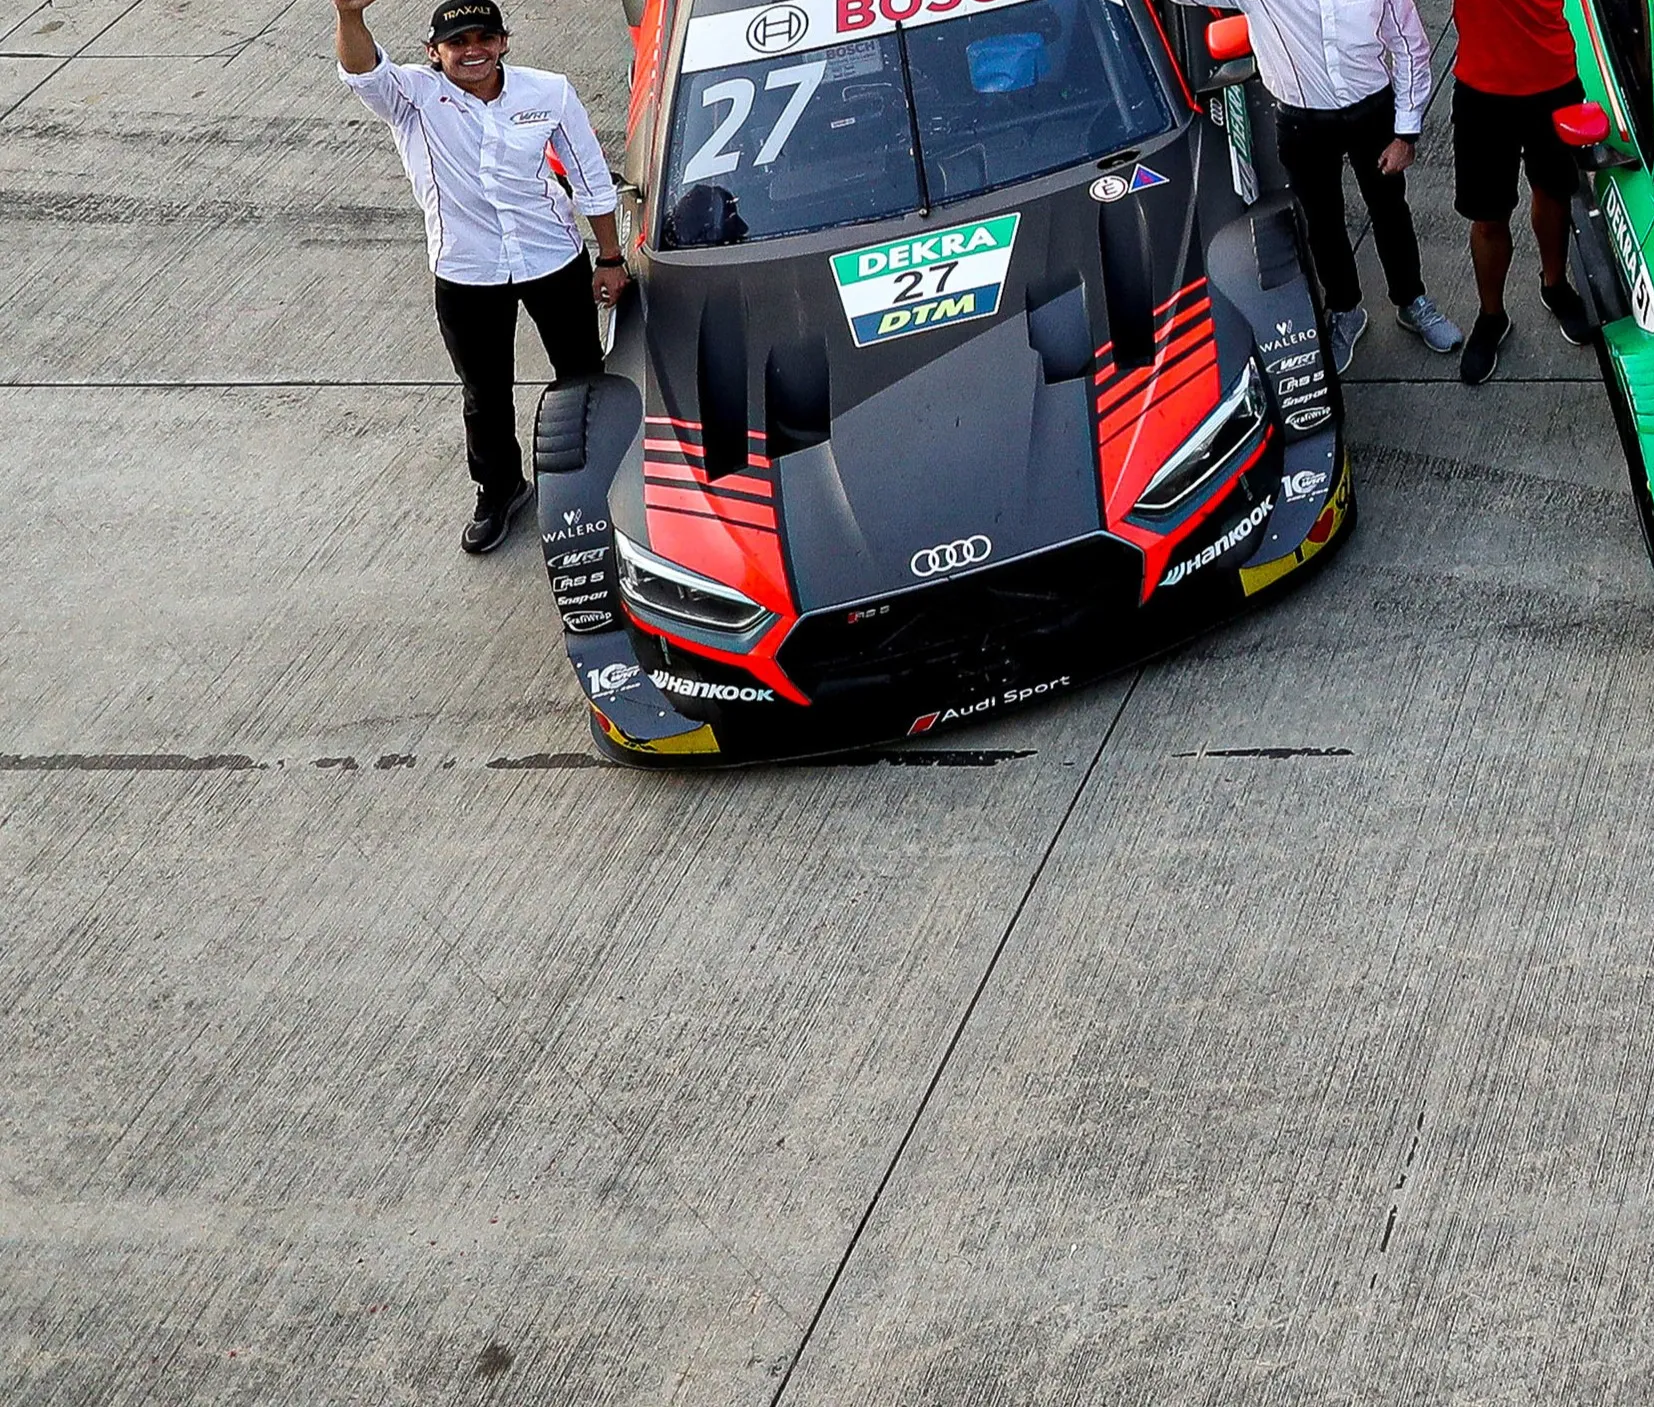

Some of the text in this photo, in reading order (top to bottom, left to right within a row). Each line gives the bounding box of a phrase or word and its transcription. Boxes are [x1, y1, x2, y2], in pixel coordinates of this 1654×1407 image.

[825, 41, 876, 59] BOSCH
[682, 59, 828, 184] 27
[857, 224, 998, 280] DEKRA
[1606, 187, 1638, 284] DEKRA
[893, 262, 961, 305] 27
[877, 294, 977, 335] DTM
[1259, 328, 1317, 353] WALERO
[542, 519, 607, 544] WALERO
[942, 674, 1071, 722] Audi Sport
